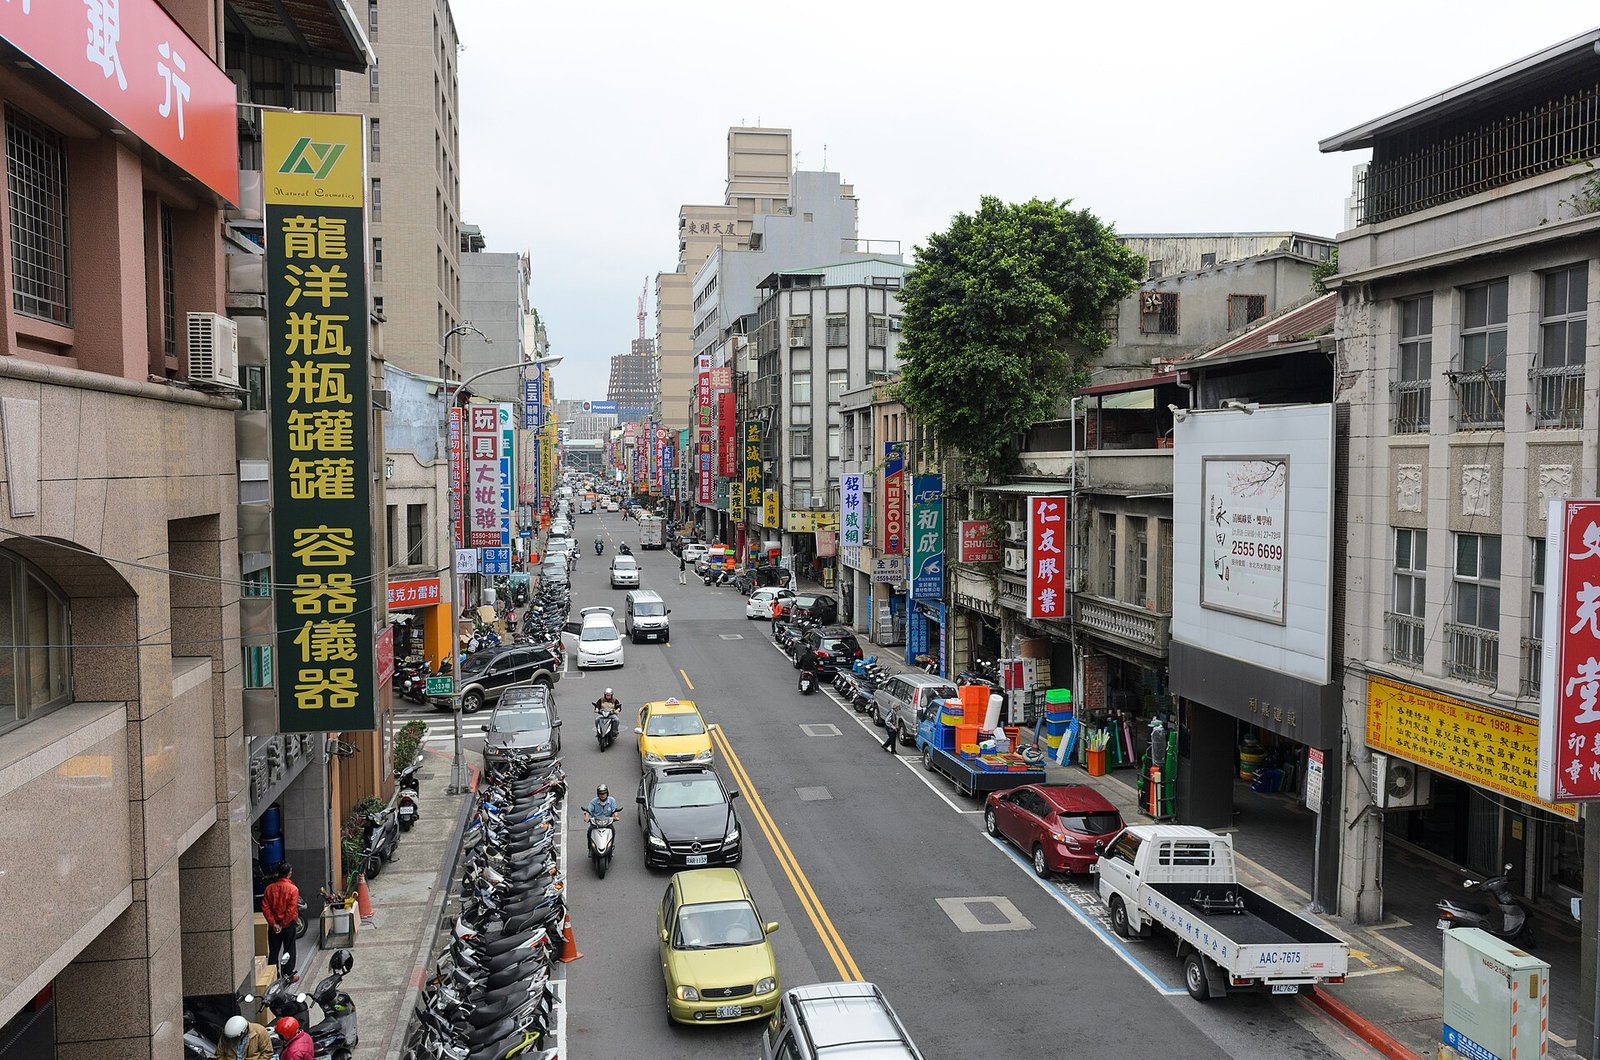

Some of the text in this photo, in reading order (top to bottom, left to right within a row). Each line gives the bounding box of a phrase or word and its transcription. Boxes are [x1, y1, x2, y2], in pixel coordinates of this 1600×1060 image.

[274, 187, 356, 200] Natural Cosmetics
[687, 221, 736, 236] 東明天廈
[711, 369, 729, 387] 鞋
[282, 215, 359, 710] 龍洋瓶瓶罐罐 容器儀器
[474, 409, 497, 530] 玩具大批發
[731, 484, 743, 520] 整理箱
[888, 477, 900, 534] TENCO
[917, 509, 939, 553] 和成
[485, 549, 508, 560] 包材
[1037, 501, 1061, 614] 仁友膠業
[1231, 540, 1282, 561] 2555 6699
[1490, 718, 1511, 733] 1958
[1512, 723, 1524, 736] 年
